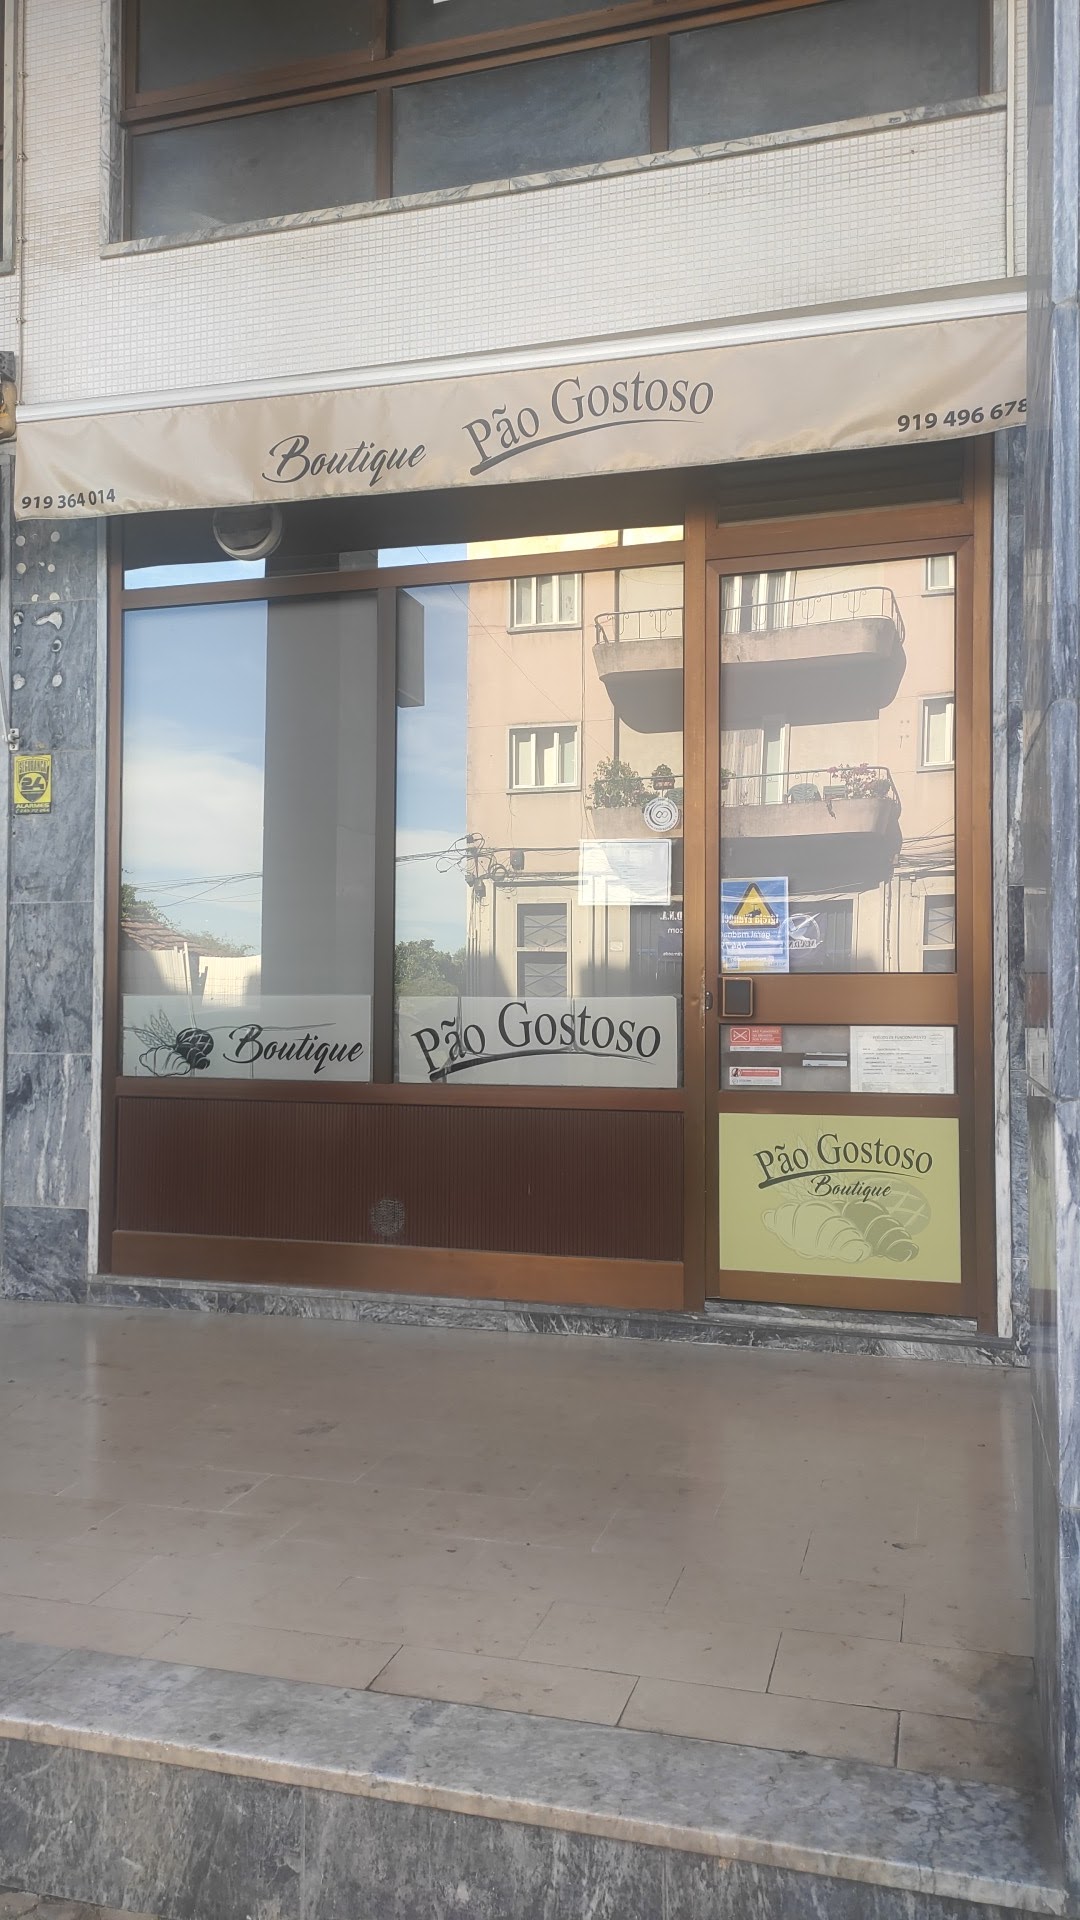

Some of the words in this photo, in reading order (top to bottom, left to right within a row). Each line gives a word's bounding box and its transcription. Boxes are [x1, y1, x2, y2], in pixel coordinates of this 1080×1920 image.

[261, 434, 427, 487] Boutique
[462, 405, 540, 465] Pão
[550, 371, 714, 426] Gostoso
[897, 413, 938, 433] 919
[943, 407, 985, 427] 496
[990, 398, 1027, 420] 678
[21, 496, 53, 509] 919
[57, 492, 86, 509] 364
[88, 488, 116, 506] 014
[21, 777, 44, 790] 24
[222, 1024, 364, 1074] Boutique
[411, 1018, 486, 1075] Pão
[497, 1001, 662, 1058] Gostoso
[753, 1144, 809, 1181] Pão
[817, 1133, 933, 1174] Gostoso
[807, 1174, 892, 1203] Boutique
